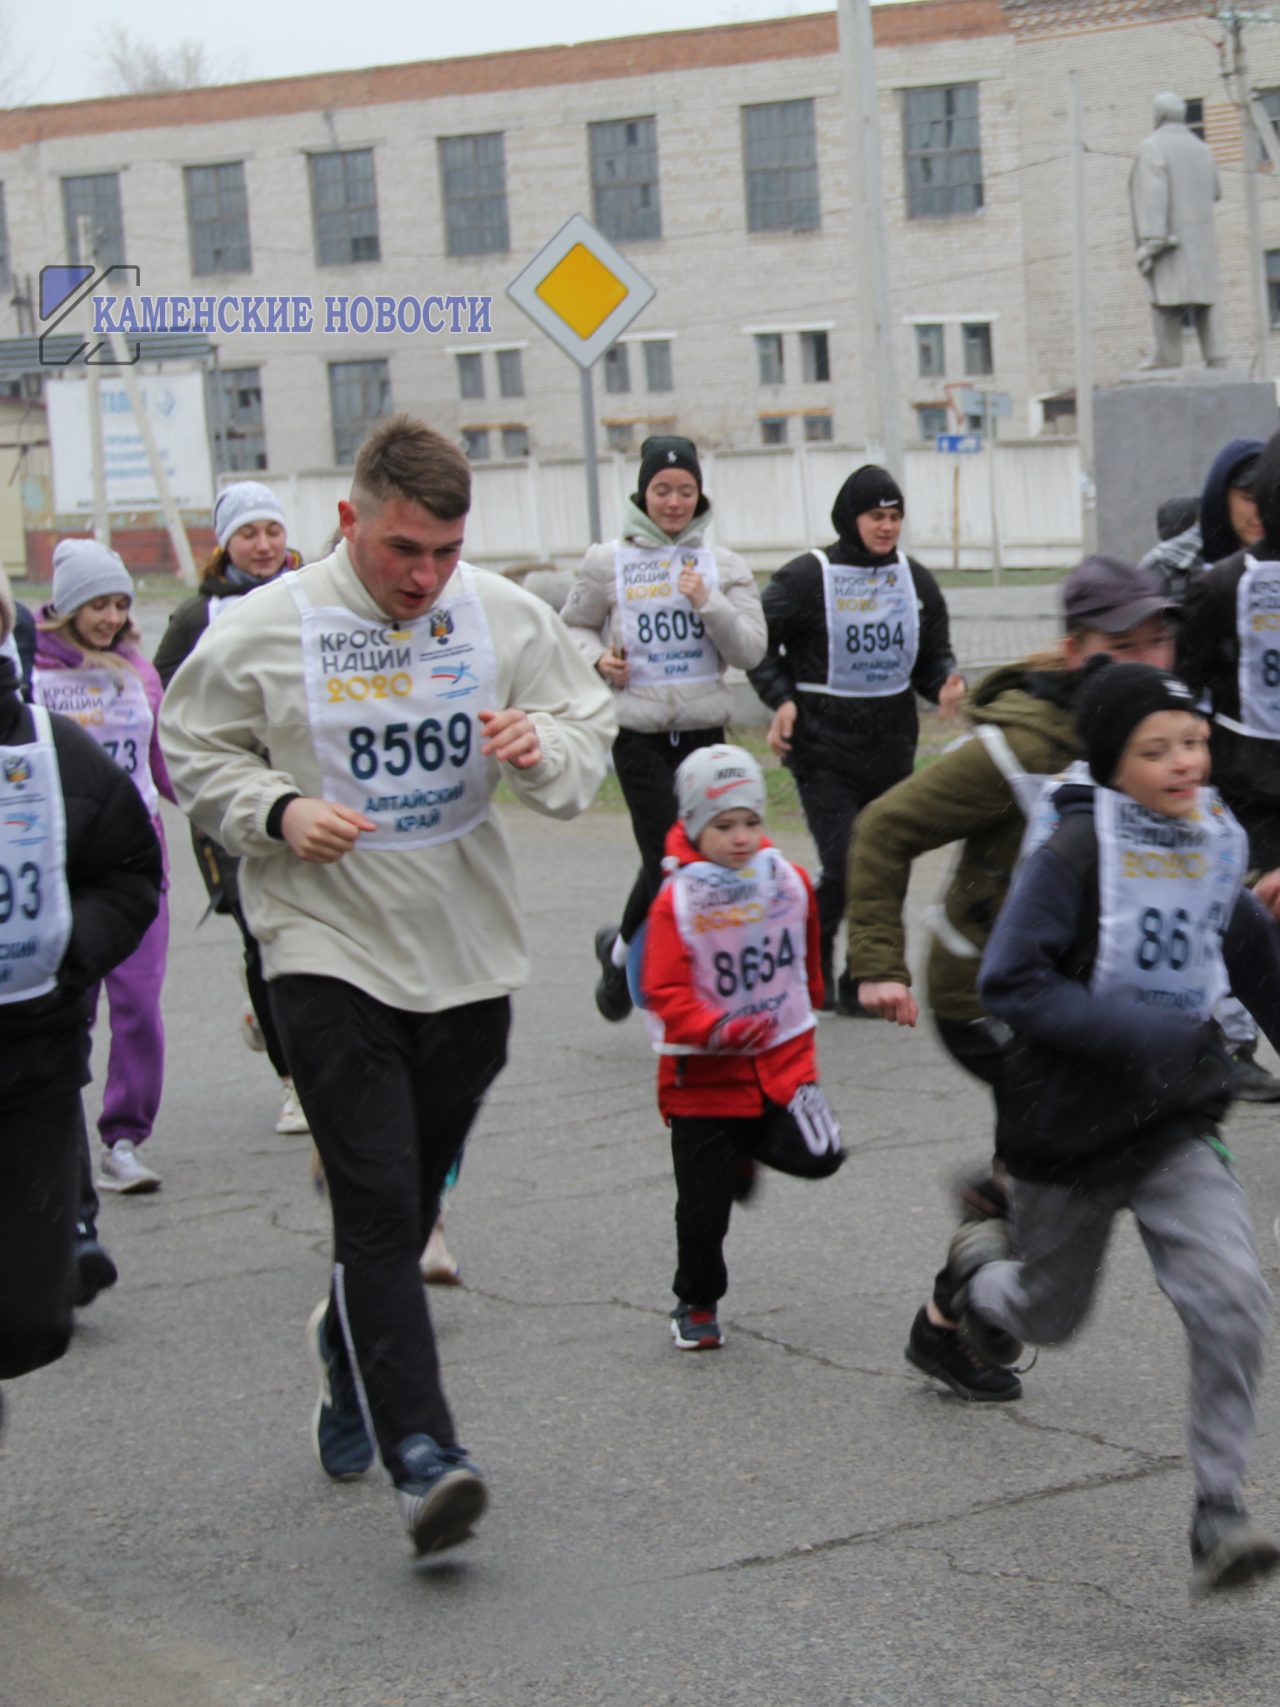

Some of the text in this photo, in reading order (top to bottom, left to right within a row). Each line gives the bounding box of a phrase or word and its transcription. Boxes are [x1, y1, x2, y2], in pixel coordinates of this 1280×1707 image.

[626, 582, 672, 601] 2020
[320, 629, 391, 652] КРОСС
[638, 609, 705, 644] 8609
[846, 621, 905, 654] 8594
[322, 648, 413, 674] НАЦИИ
[326, 671, 413, 703] 2020
[349, 712, 472, 781] 8569
[364, 781, 466, 813] АЛТАЙСКИЙ
[394, 811, 441, 832] КРАЙ
